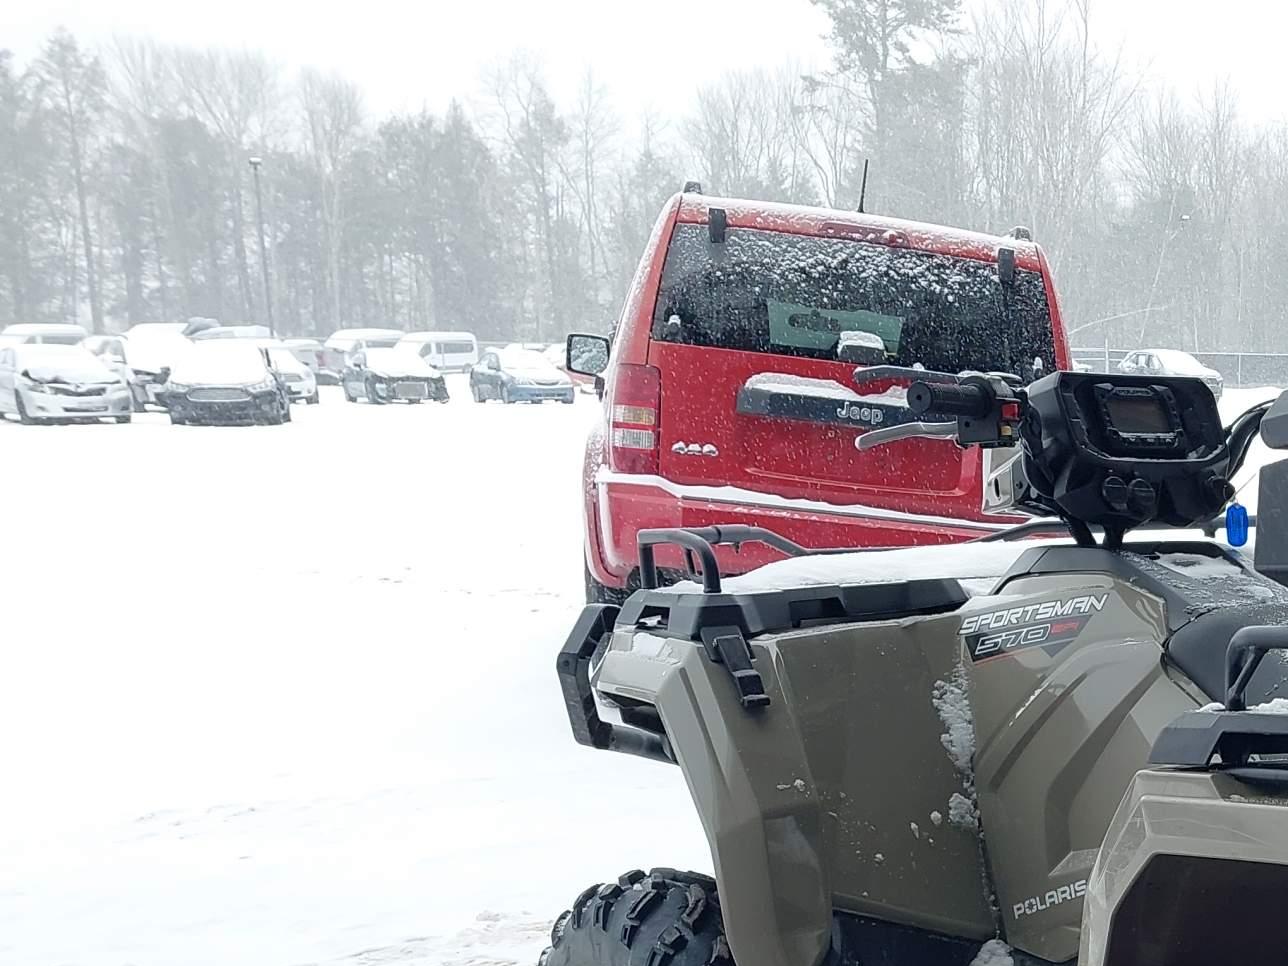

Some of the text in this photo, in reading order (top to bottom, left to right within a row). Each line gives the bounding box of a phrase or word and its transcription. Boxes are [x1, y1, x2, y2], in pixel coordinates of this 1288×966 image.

[836, 401, 884, 425] Jeep
[958, 593, 1110, 635] SPORTSMAN
[974, 623, 1051, 656] 570
[1012, 879, 1088, 920] POLARIS
